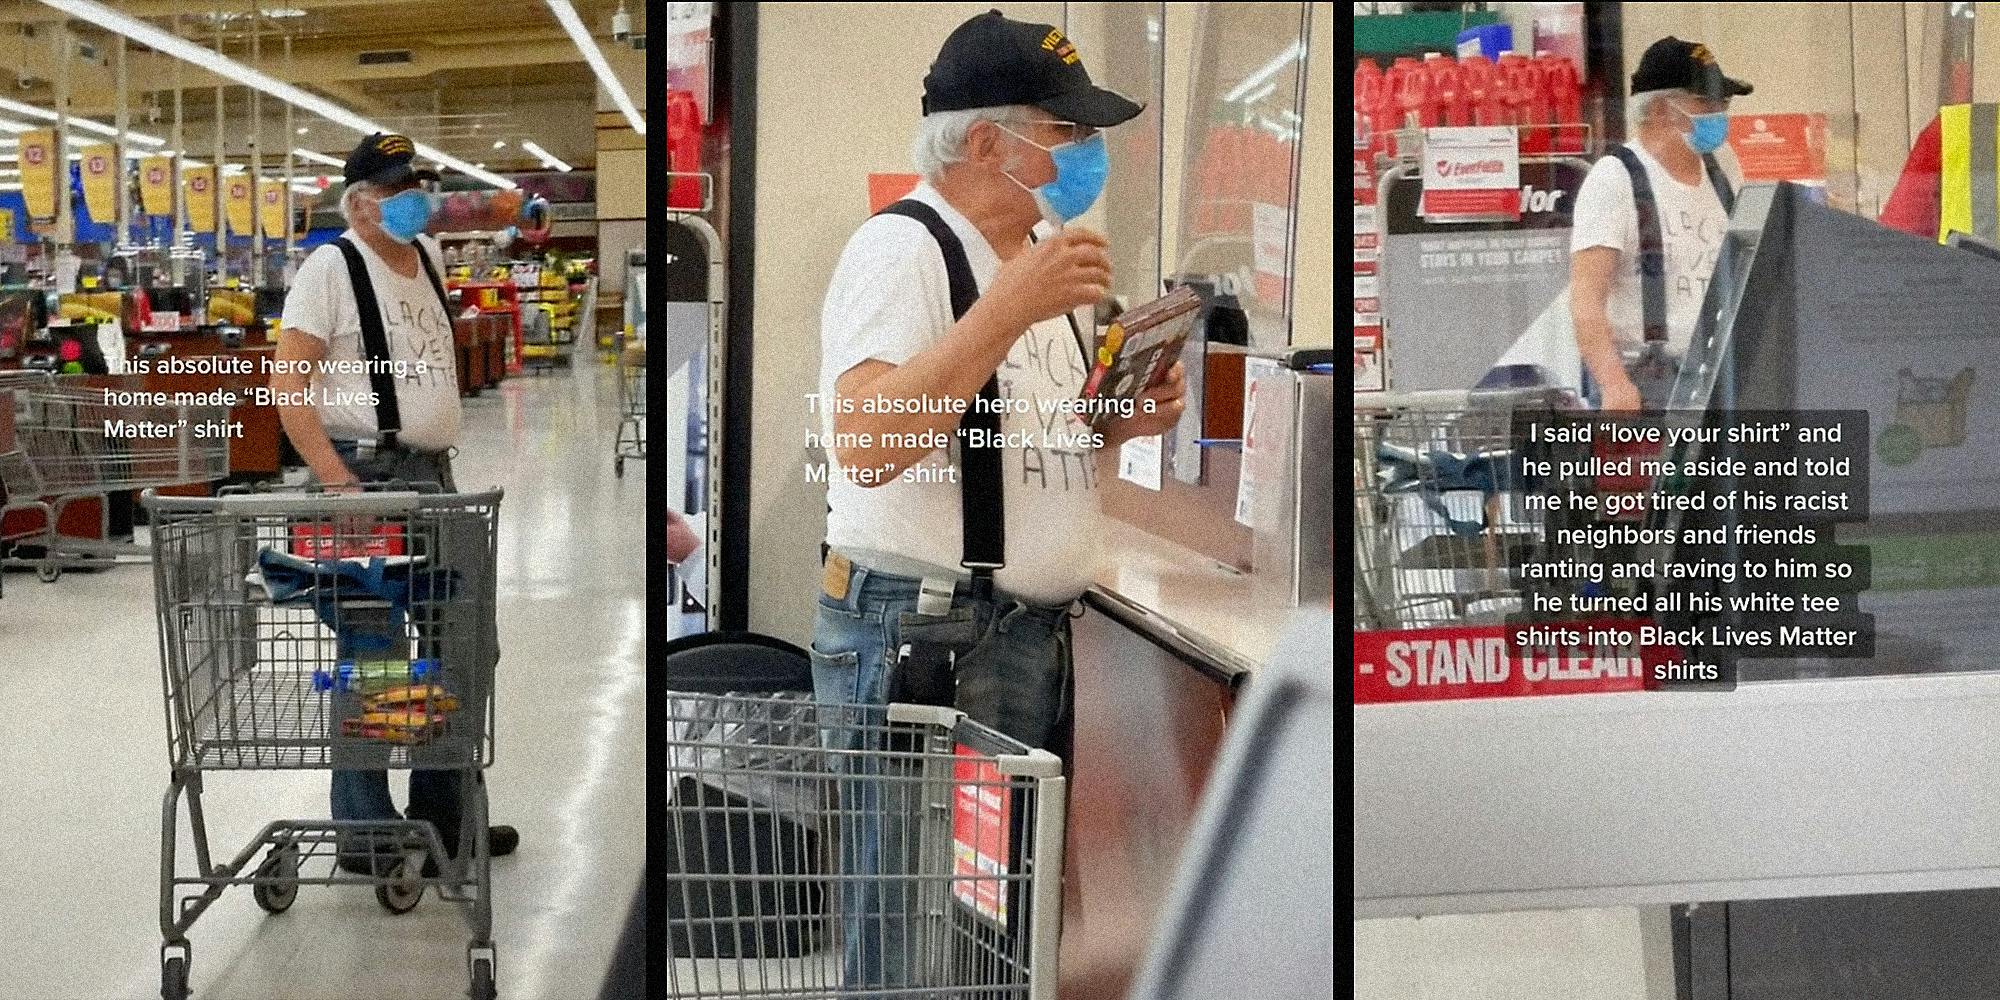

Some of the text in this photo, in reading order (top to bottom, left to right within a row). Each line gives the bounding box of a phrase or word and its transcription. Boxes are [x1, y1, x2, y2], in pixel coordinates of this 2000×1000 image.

[1420, 252, 1457, 268] STAYS
[384, 299, 449, 335] LACK
[1386, 637, 1510, 687] STAND
